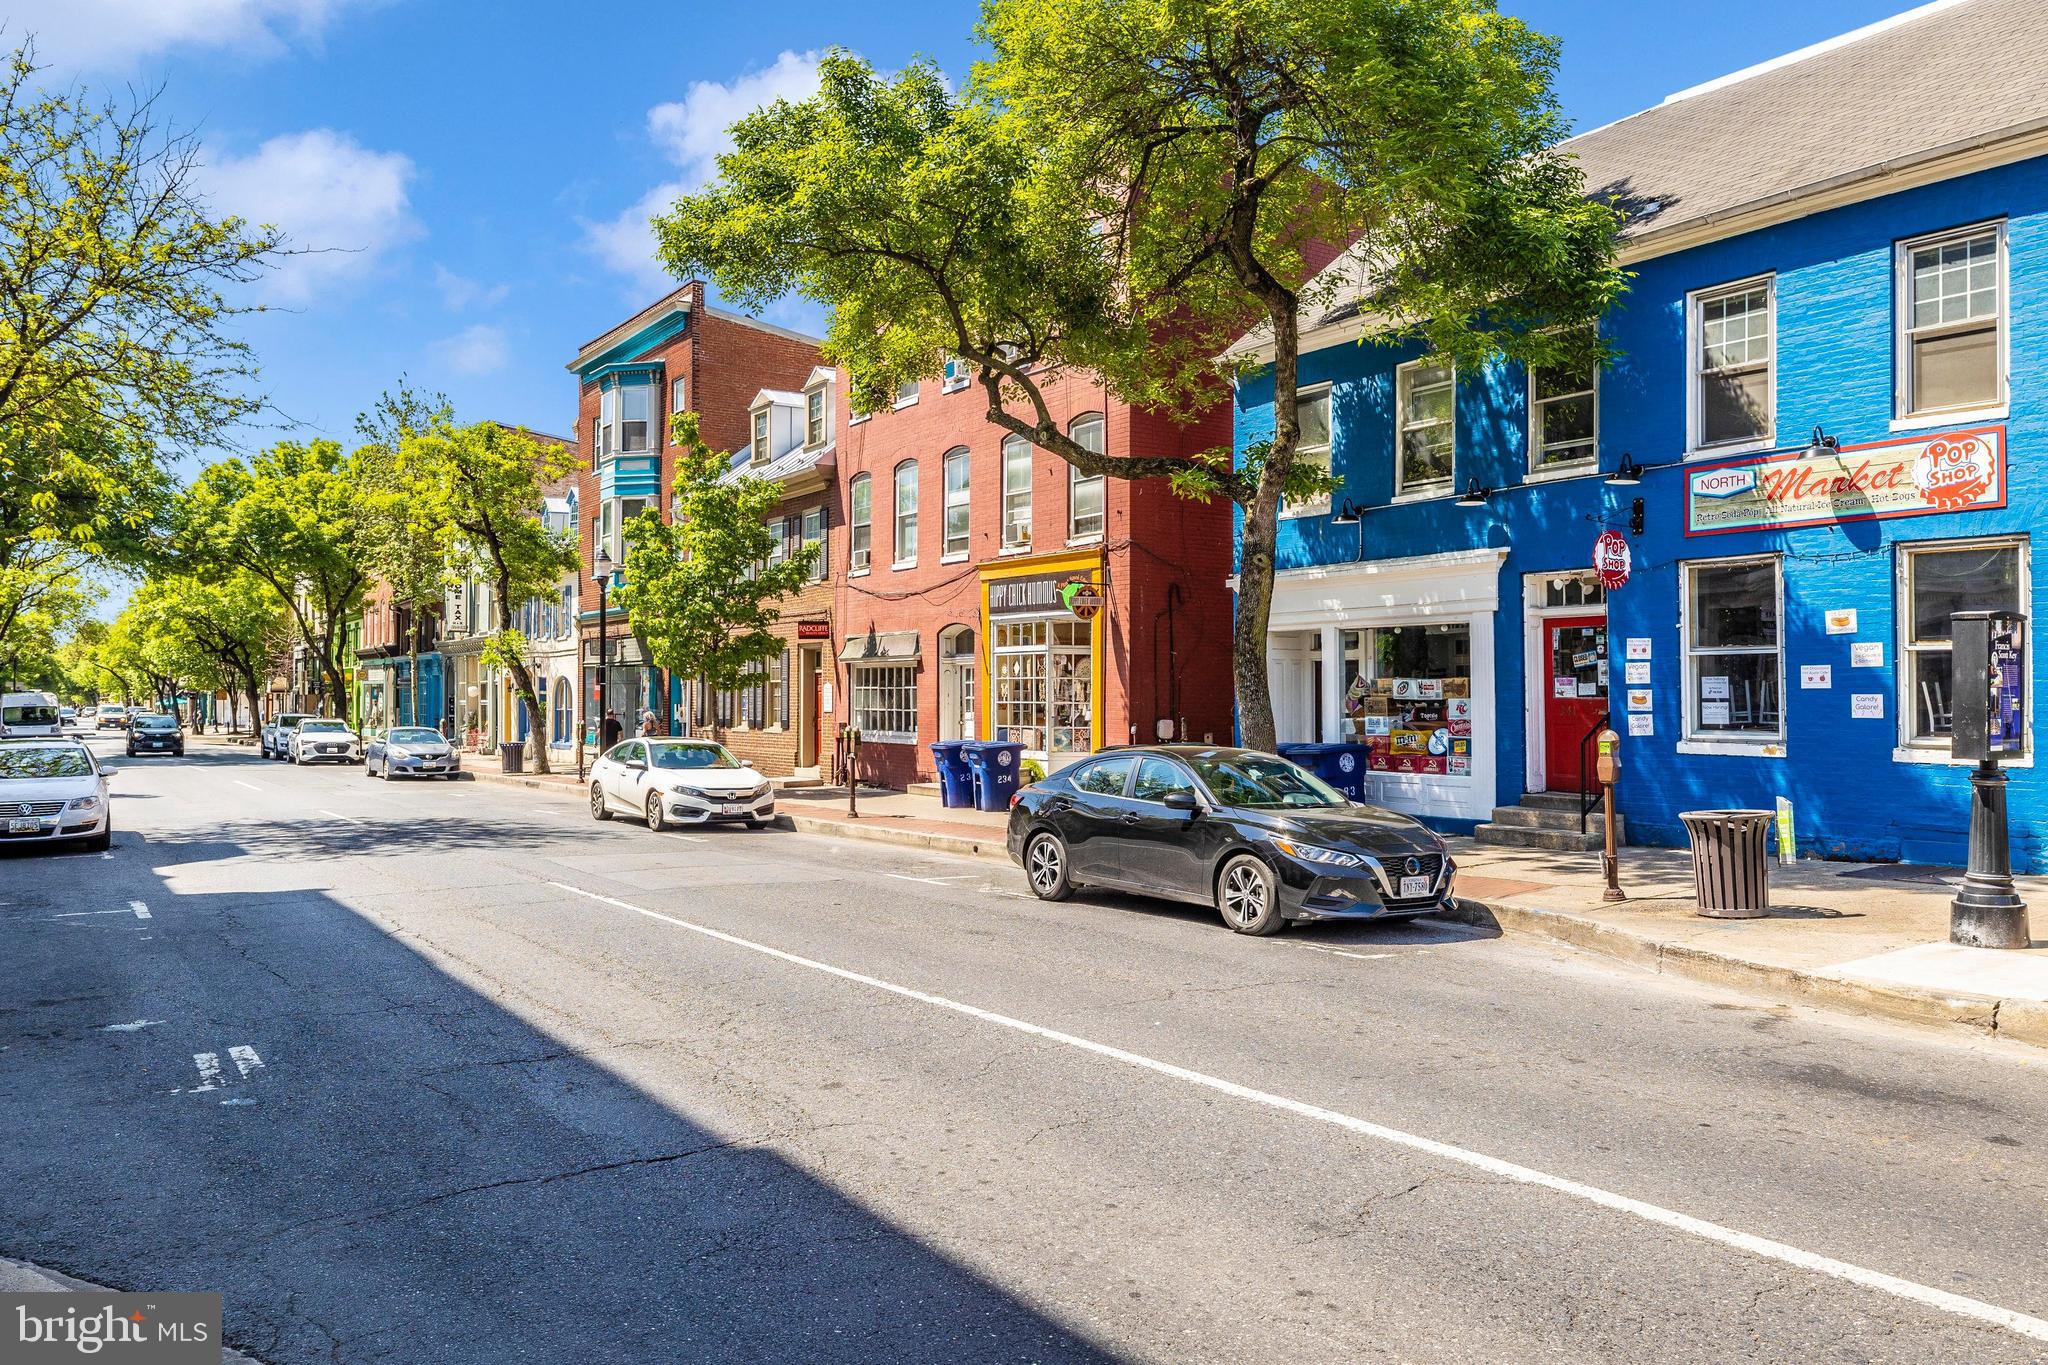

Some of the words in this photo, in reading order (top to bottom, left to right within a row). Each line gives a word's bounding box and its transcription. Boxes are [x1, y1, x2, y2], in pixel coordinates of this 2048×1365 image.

[1928, 441, 1976, 468] POP
[1700, 474, 1746, 491] NORTH
[1762, 459, 1904, 501] Market
[1929, 465, 1977, 486] SHOP
[1696, 512, 1720, 522] Retro
[1721, 509, 1741, 519] Soda
[1765, 506, 1778, 514] All
[1781, 501, 1815, 513] Natural
[1818, 500, 1831, 509] Ice
[1871, 493, 1889, 503] Hot
[1892, 492, 1916, 503] Dogs
[1603, 534, 1626, 557] POP
[1602, 558, 1626, 570] SHOP
[1027, 580, 1057, 605] HUMMUS
[454, 604, 462, 621] TAX
[1853, 644, 1880, 652] Vegan
[1994, 640, 2010, 650] Francis
[997, 774, 1012, 784] 234
